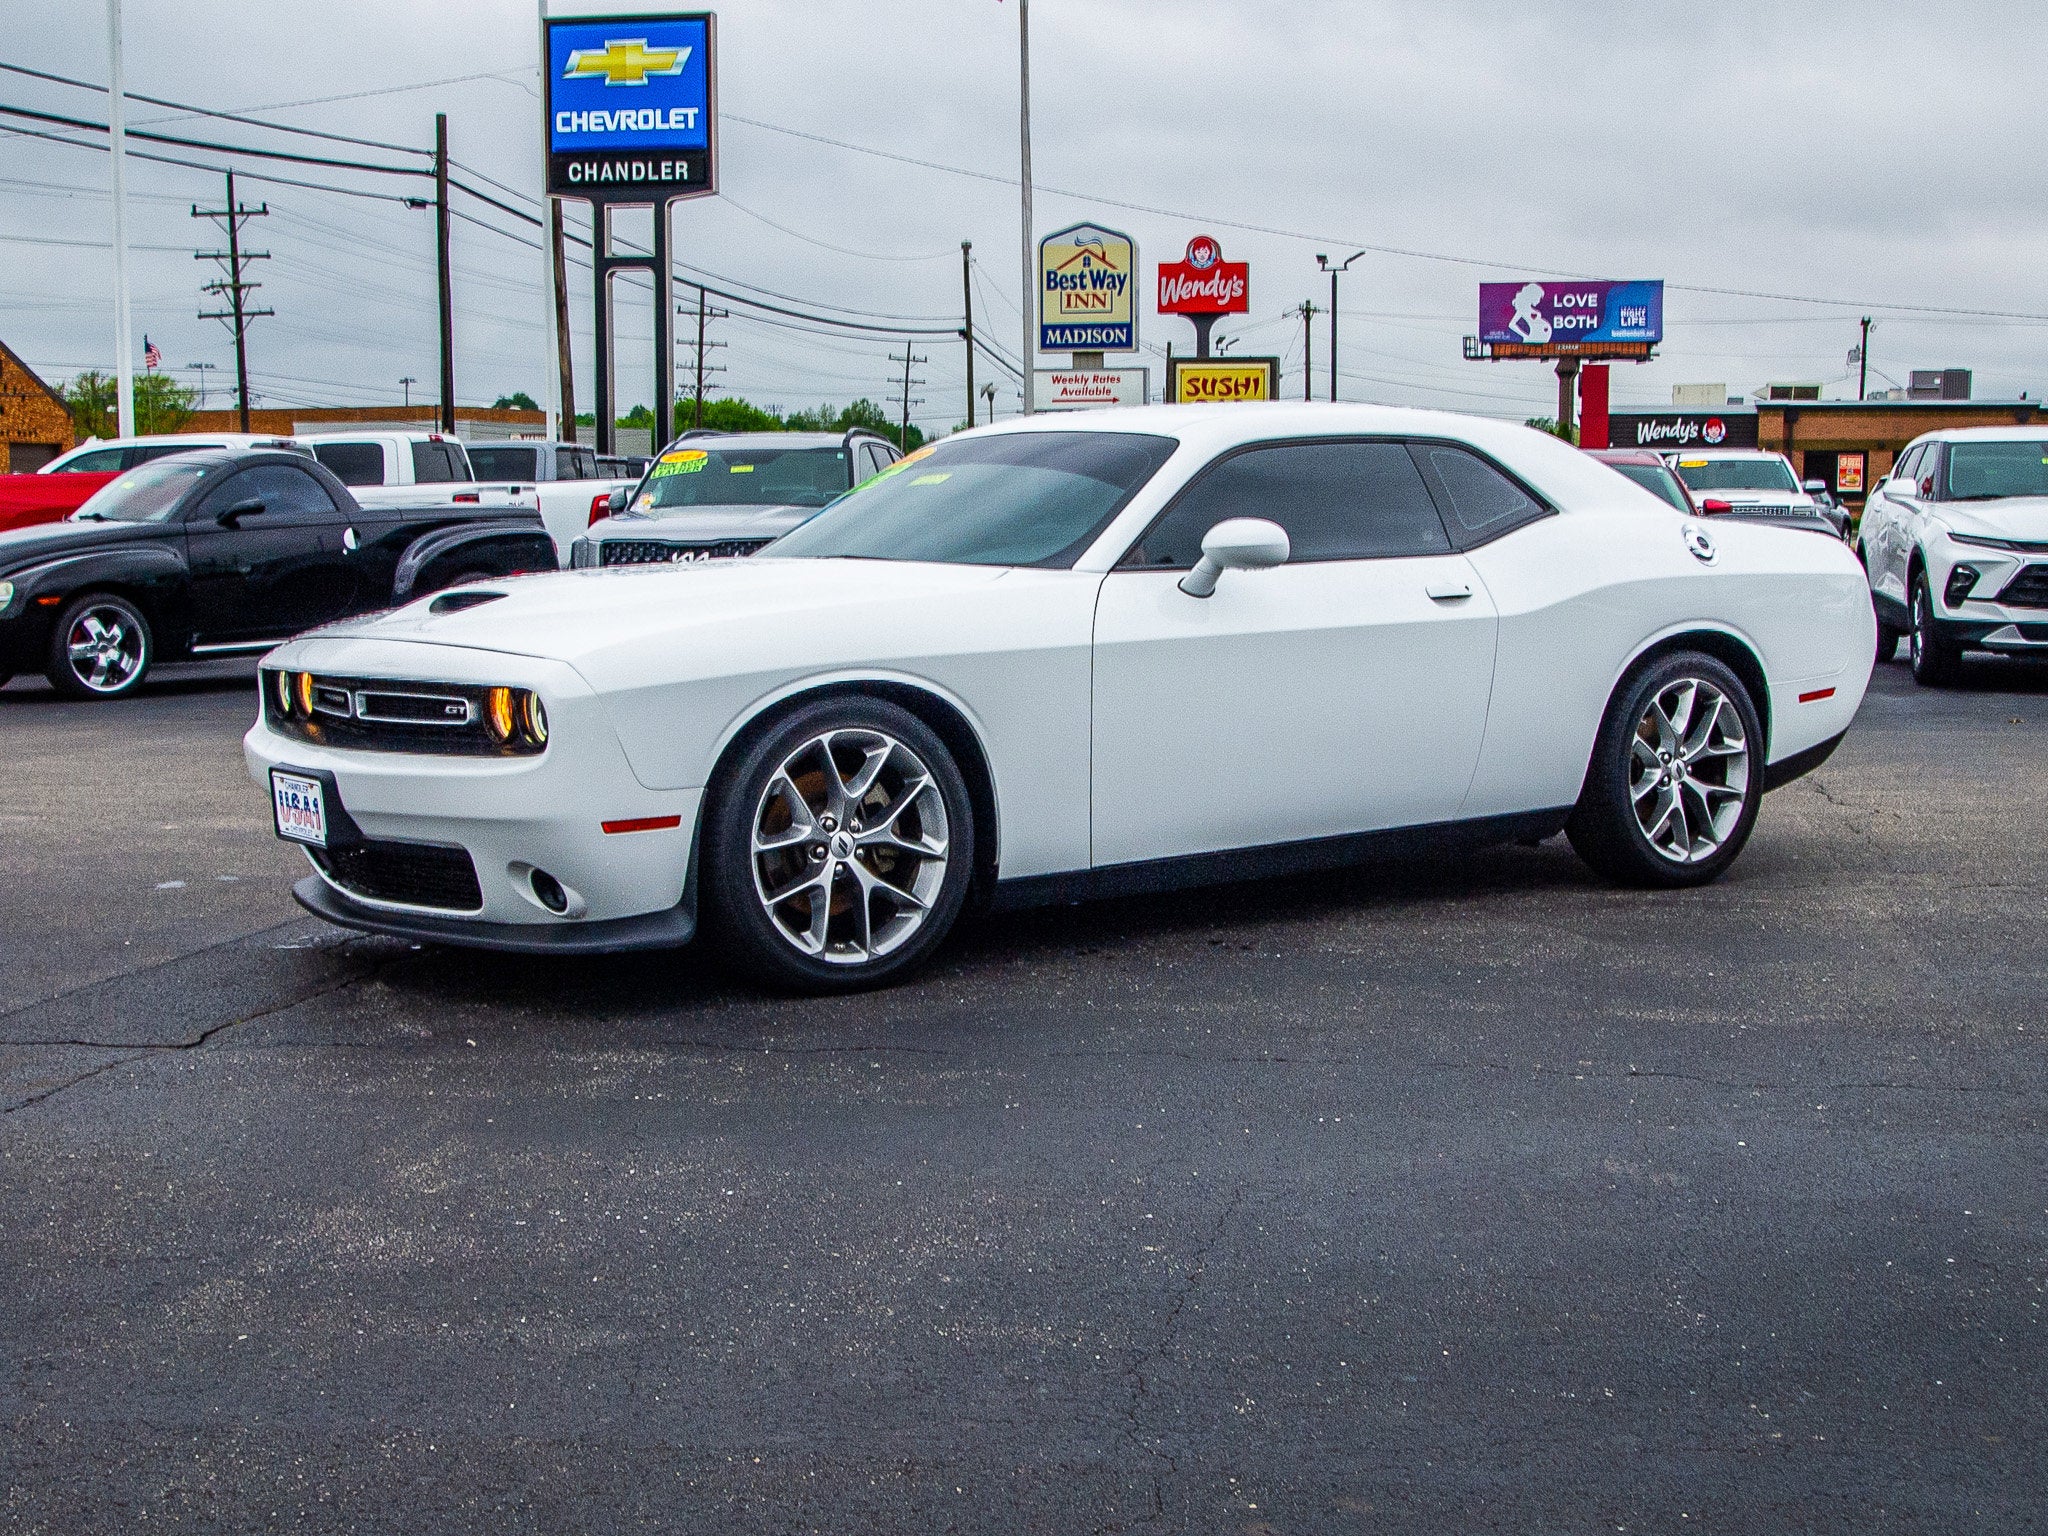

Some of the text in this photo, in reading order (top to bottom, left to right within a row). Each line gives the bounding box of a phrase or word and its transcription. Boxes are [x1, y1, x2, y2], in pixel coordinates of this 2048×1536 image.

[556, 107, 698, 132] CHEVROLET
[568, 160, 689, 182] CHANDLER
[1046, 269, 1127, 296] Best Way
[1161, 269, 1244, 306] Wendy's
[1065, 293, 1107, 308] INN
[1553, 293, 1598, 308] LOVE
[1553, 315, 1598, 329] BOTH
[1620, 317, 1646, 327] LIFE
[1046, 329, 1127, 344] MADISON
[1052, 374, 1121, 386] Weekly Rates
[1186, 376, 1260, 397] SUSHI
[1060, 386, 1112, 397] Available
[1637, 417, 1699, 445] Wendy's
[445, 706, 467, 715] GT
